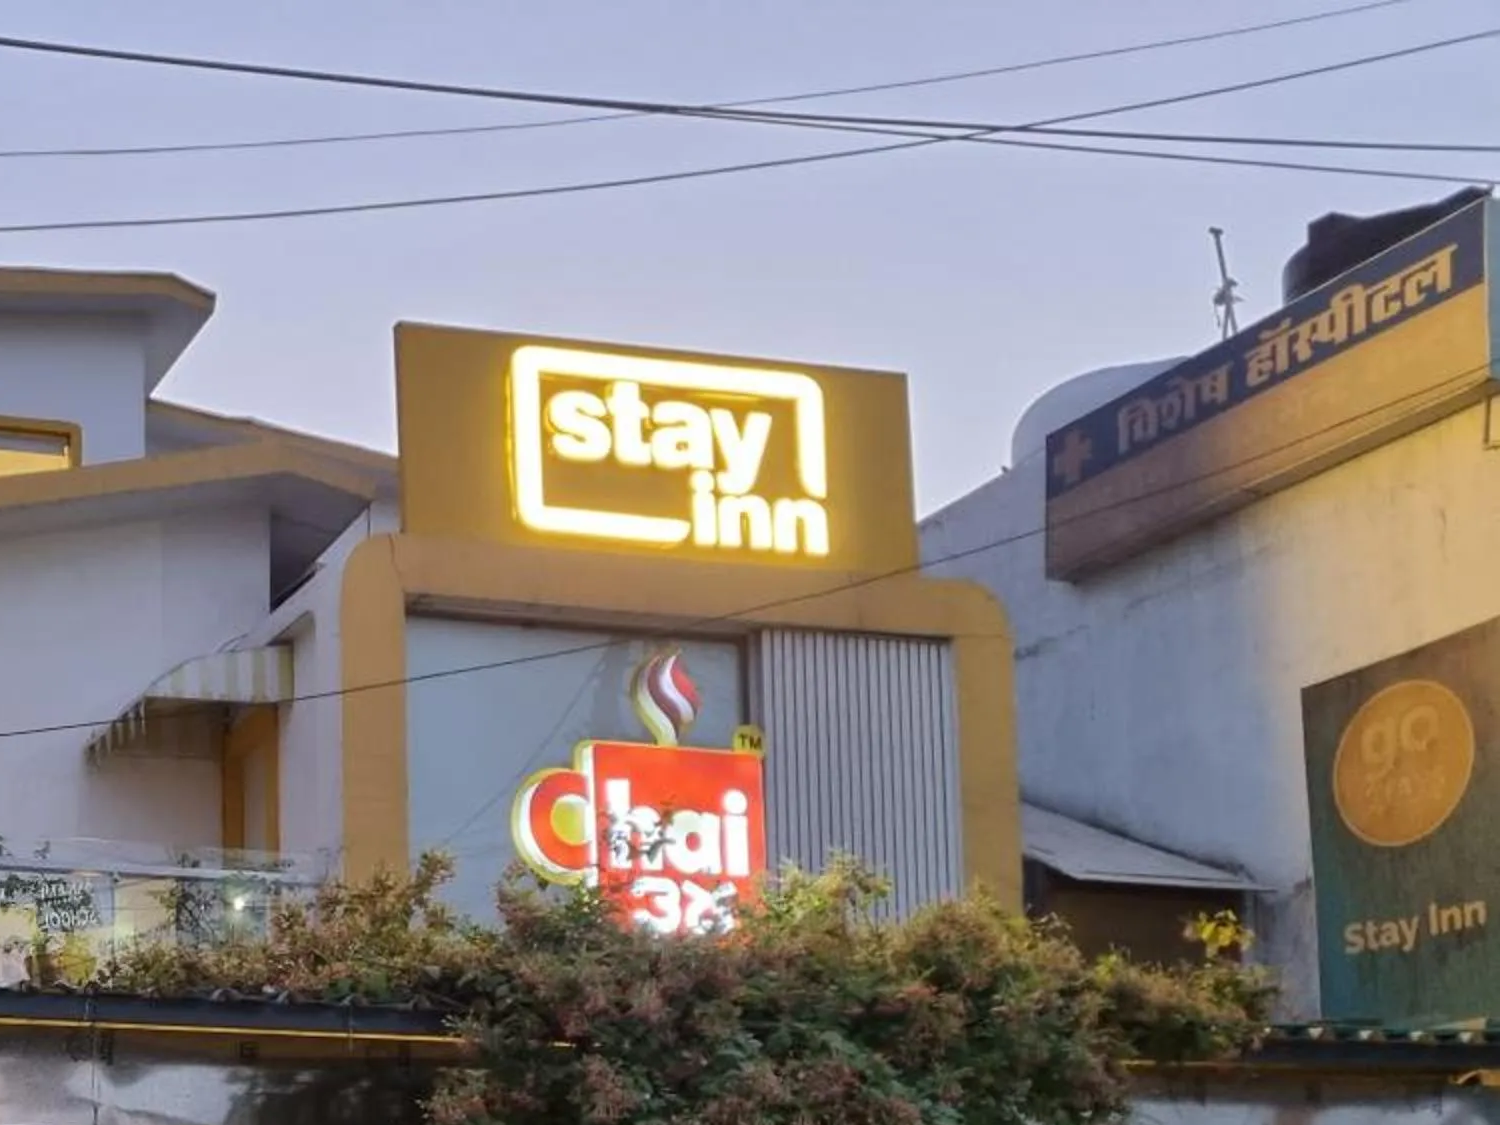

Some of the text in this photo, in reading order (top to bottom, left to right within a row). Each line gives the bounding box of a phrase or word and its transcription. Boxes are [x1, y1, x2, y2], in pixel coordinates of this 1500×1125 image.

[548, 380, 772, 494] stay
[690, 469, 829, 556] inn
[1344, 901, 1486, 954] Stay Inn
